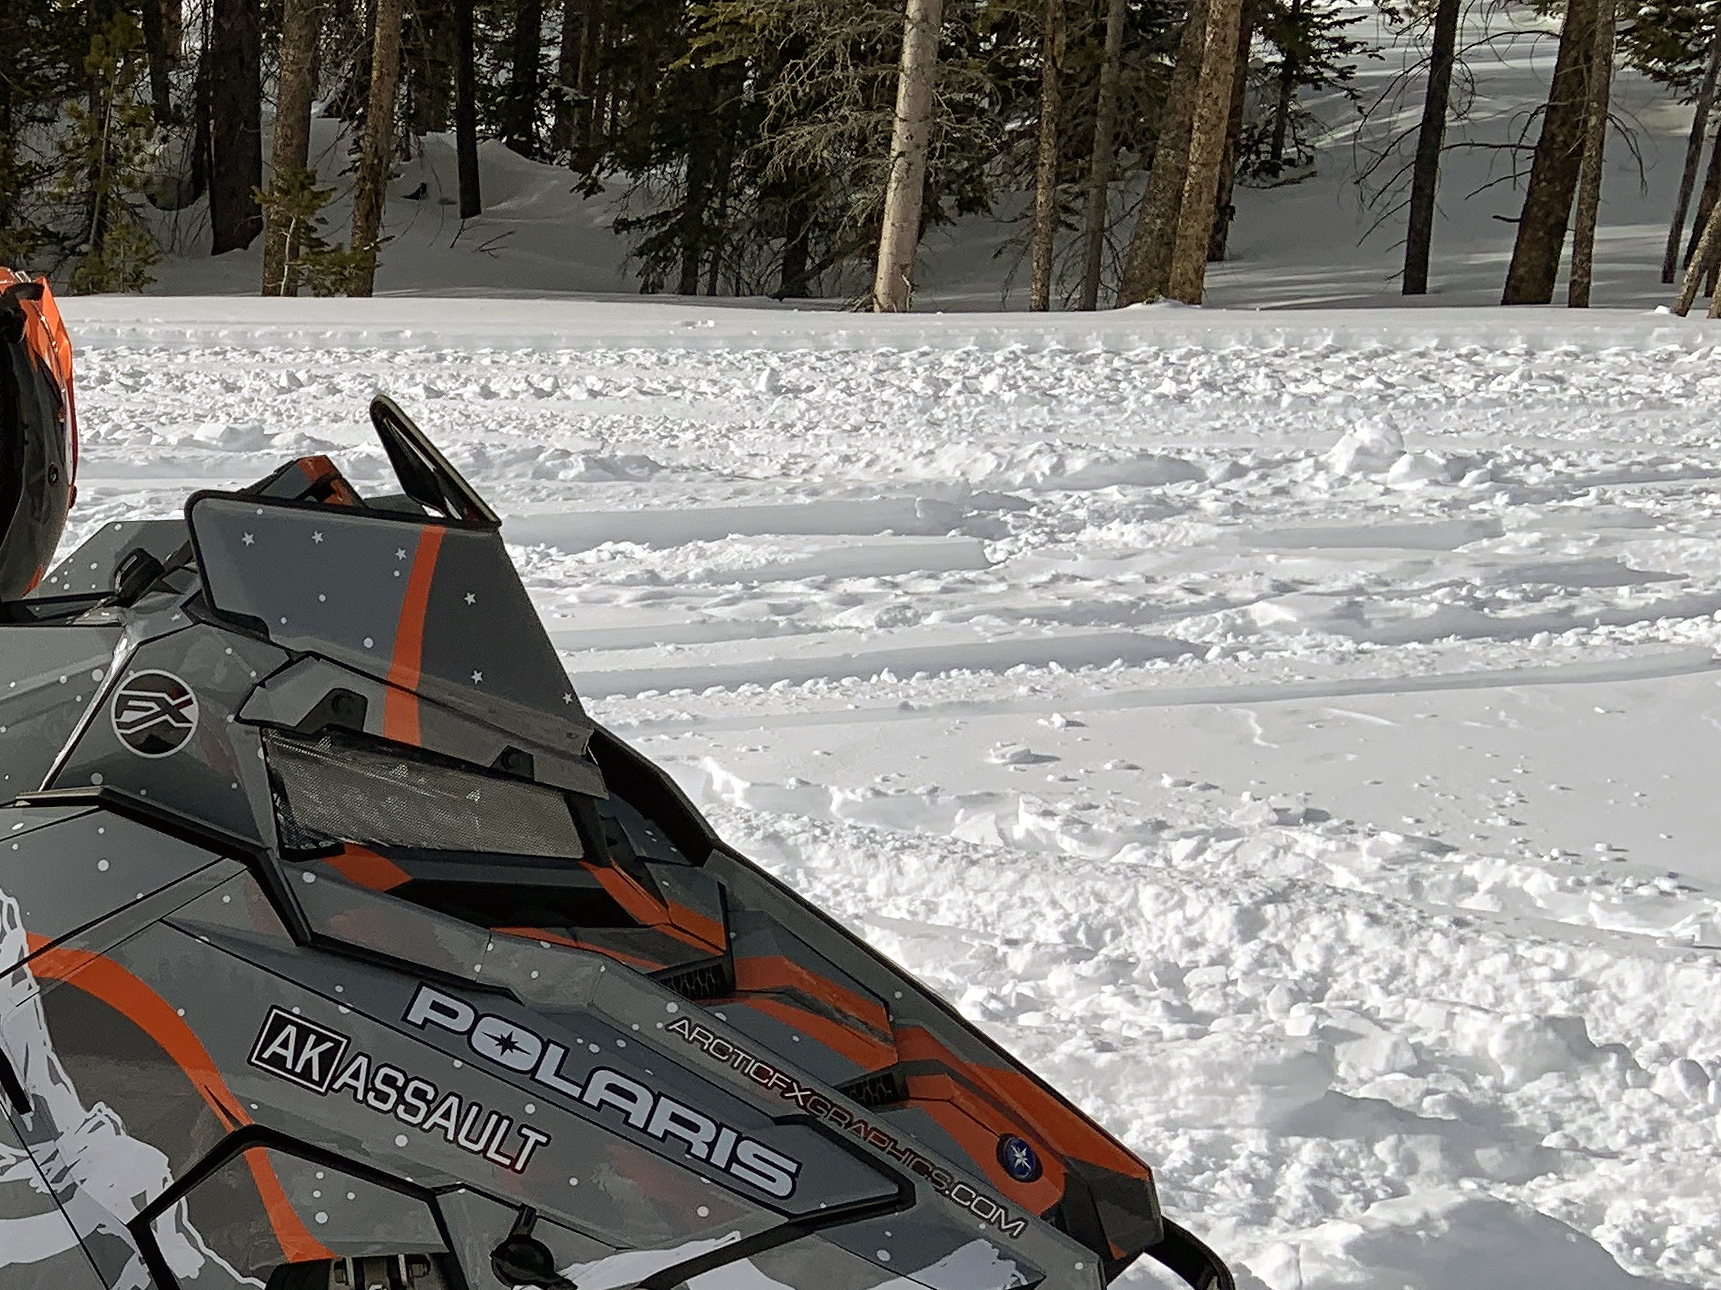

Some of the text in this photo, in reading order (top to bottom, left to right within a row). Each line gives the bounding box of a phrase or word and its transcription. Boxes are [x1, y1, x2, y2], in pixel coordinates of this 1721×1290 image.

[261, 1023, 549, 1171] AK ASSAULT
[406, 985, 799, 1198] POLARIS
[668, 1018, 1026, 1238] ARCTICFXGRAPHICS.COM
